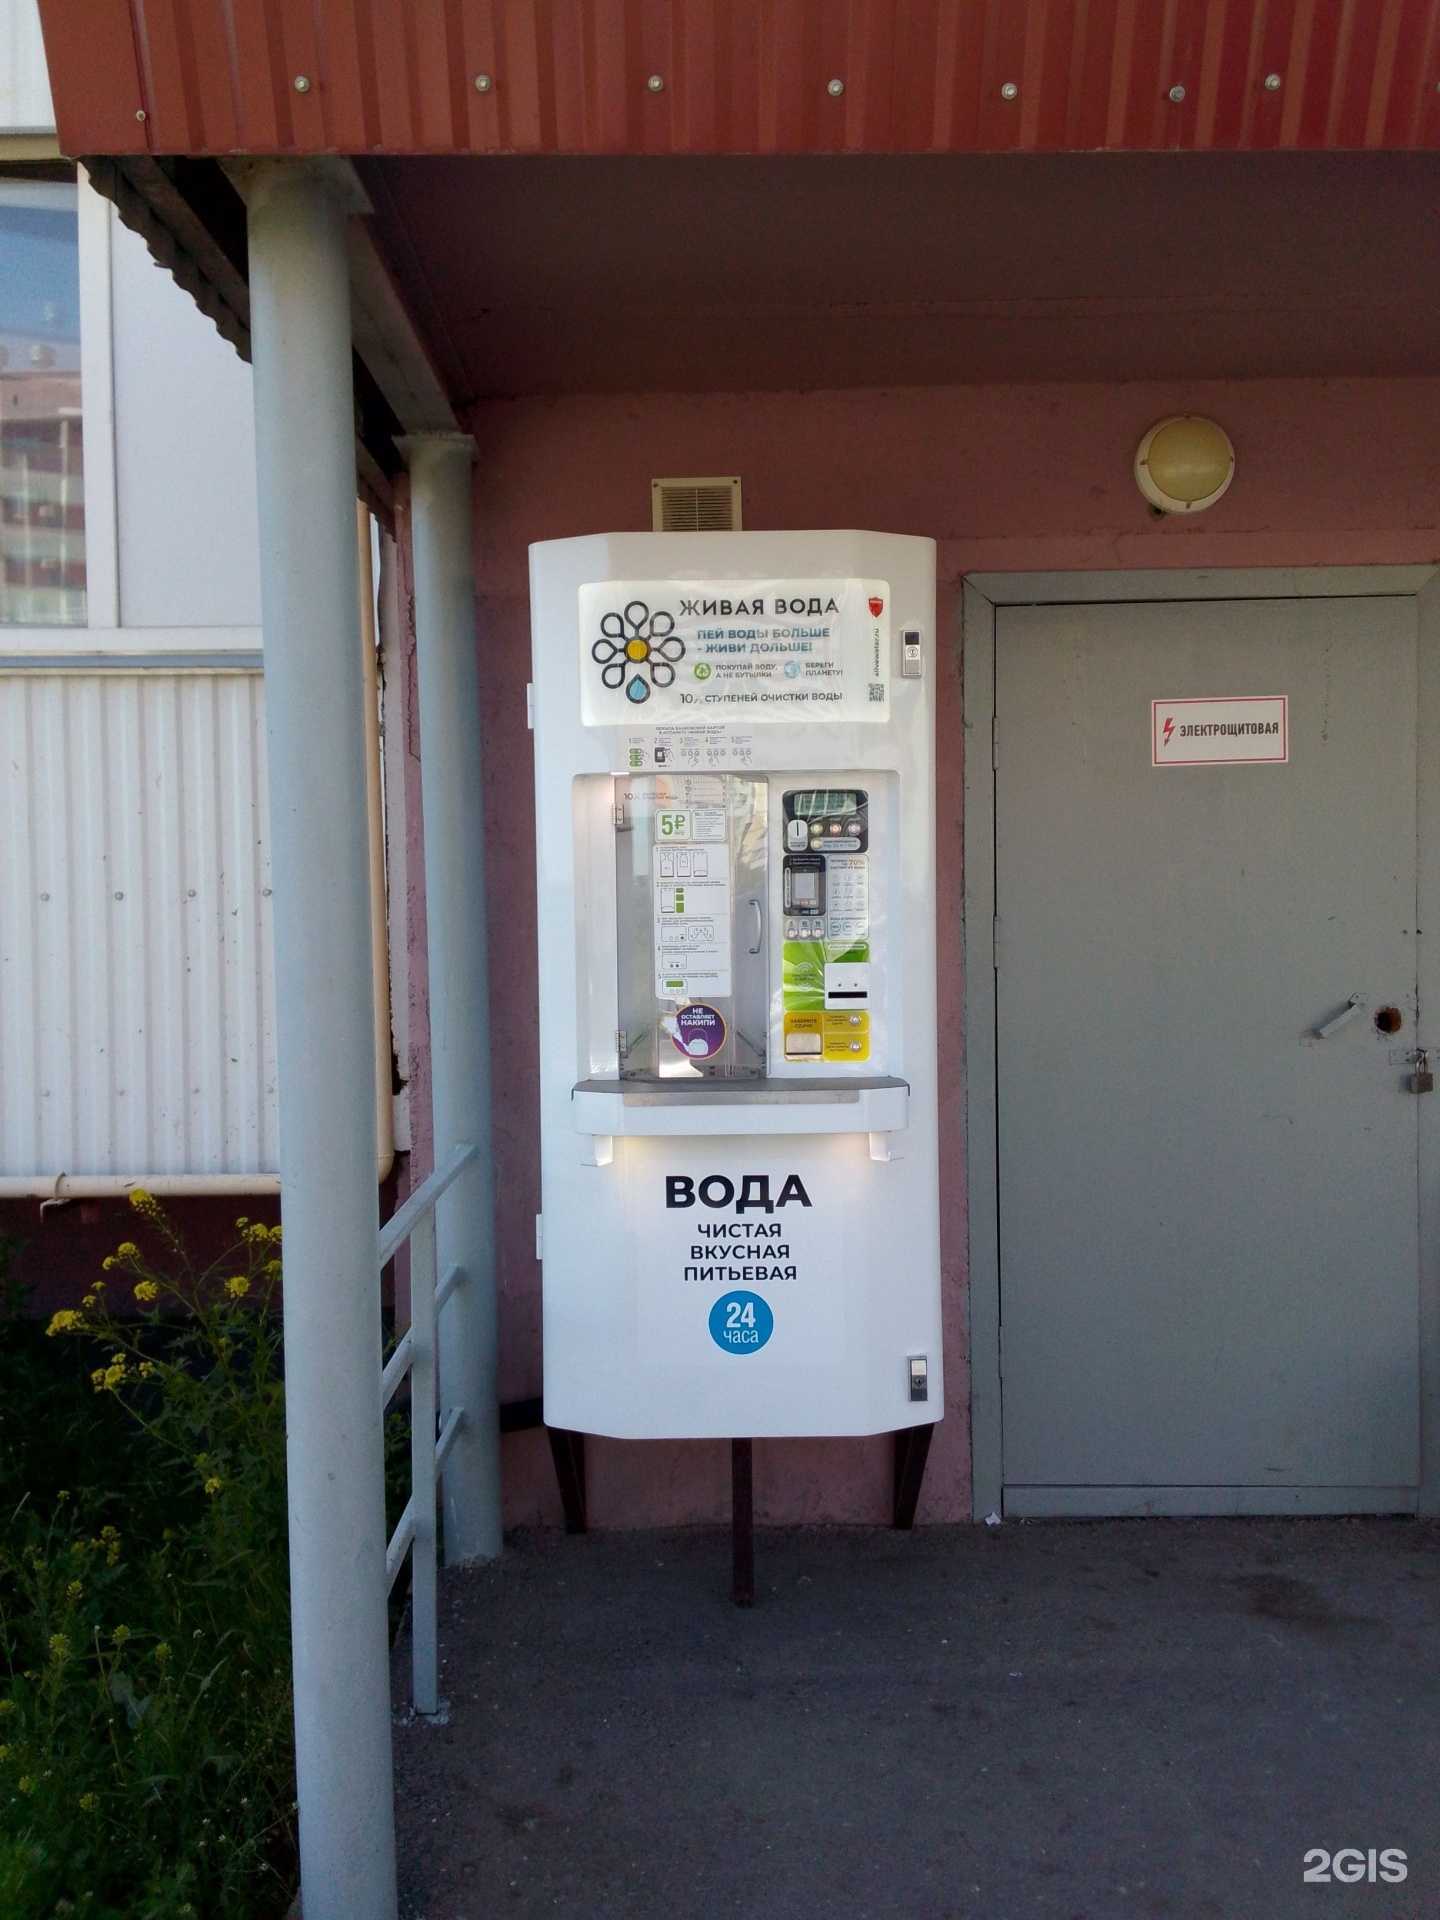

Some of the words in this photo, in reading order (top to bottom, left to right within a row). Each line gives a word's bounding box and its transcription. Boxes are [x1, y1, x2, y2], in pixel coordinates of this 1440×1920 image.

[679, 599, 764, 616] ЖИВАЯ
[774, 597, 839, 616] ВОДА
[697, 627, 724, 640] ПЕЙ
[728, 628, 769, 640] ВОДЫ
[772, 627, 831, 639] БОЛЬШЕ
[705, 642, 747, 653] ЖИВИ
[750, 641, 813, 654] ДОЛЬШЕ!
[715, 662, 753, 671] ПОКУПАЙ
[715, 671, 722, 679] А
[723, 671, 734, 679] НЕ
[704, 691, 758, 703] СТУПЕНЕЙ
[760, 692, 809, 702] ОЧИСТКИ
[811, 692, 843, 702] ВОДЫ
[1180, 721, 1279, 738] ЭЛЕКТРОЩИТОВАЯ
[692, 1007, 704, 1015] НЕ
[680, 1019, 716, 1027] НАКИПИ
[665, 1174, 813, 1214] ВОДА
[697, 1223, 782, 1238] ЧИСТАЯ
[690, 1244, 790, 1260] ВКУСНАЯ
[684, 1265, 797, 1281] ПИТЬЕВАЯ
[726, 1301, 756, 1328] 24
[723, 1329, 760, 1344] часа
